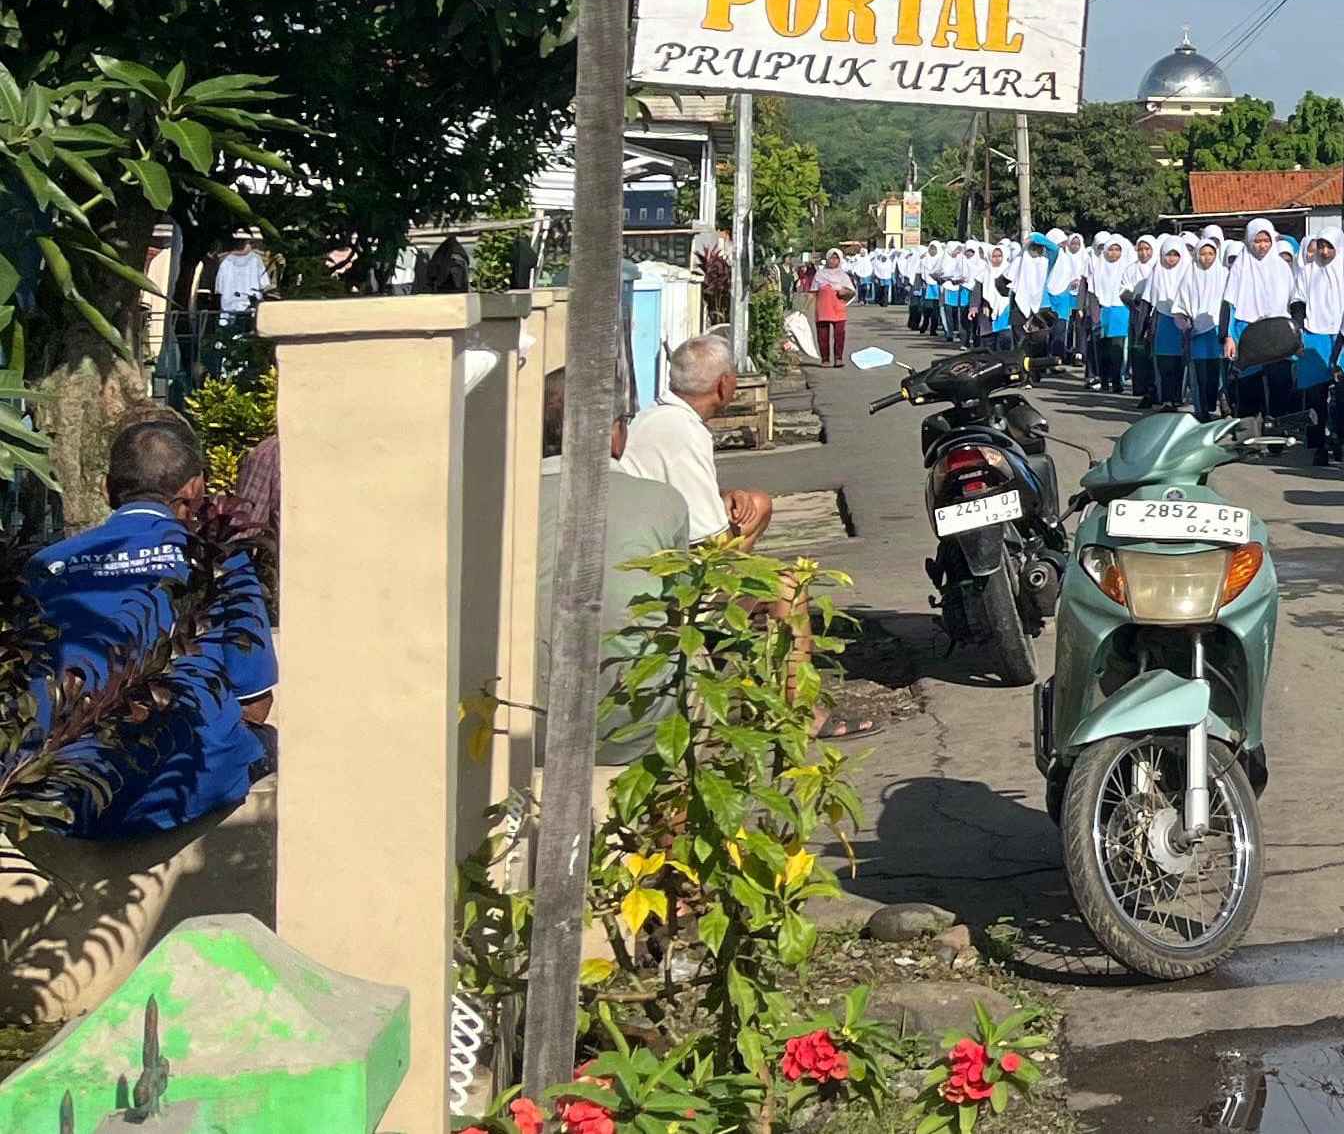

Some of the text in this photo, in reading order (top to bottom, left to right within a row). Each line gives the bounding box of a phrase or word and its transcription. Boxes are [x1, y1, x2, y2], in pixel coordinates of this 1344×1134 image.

[654, 42, 1061, 100] PRUPUK UTARA
[1145, 503, 1198, 519] 2852
[1218, 508, 1244, 523] GP
